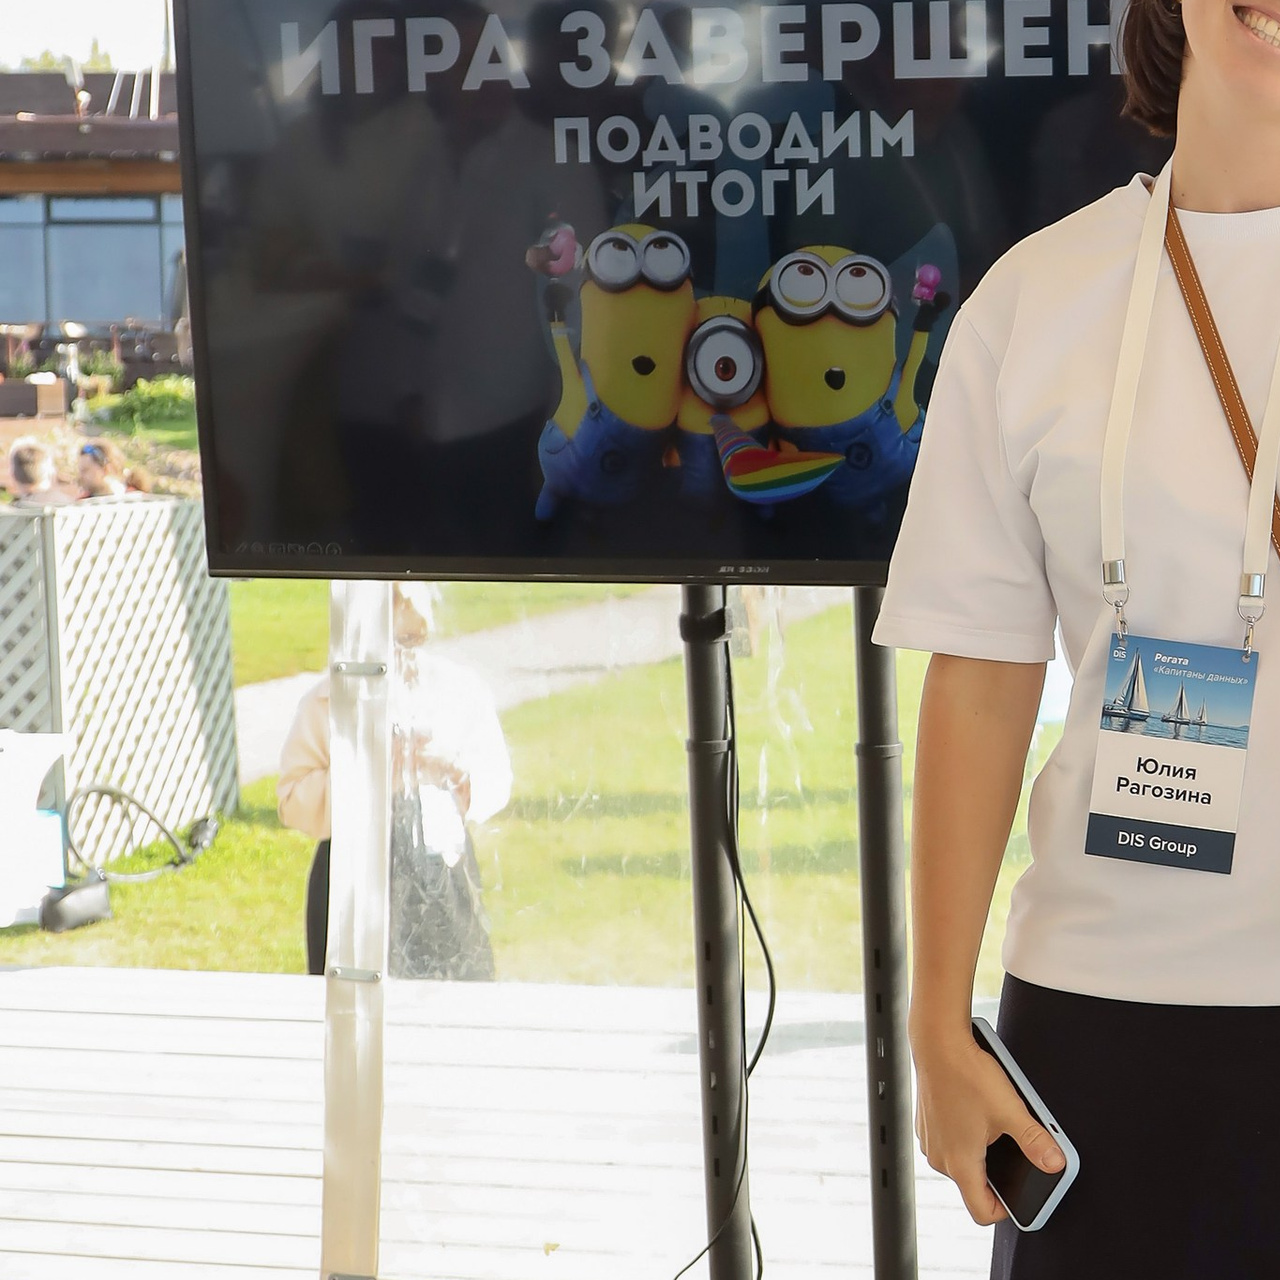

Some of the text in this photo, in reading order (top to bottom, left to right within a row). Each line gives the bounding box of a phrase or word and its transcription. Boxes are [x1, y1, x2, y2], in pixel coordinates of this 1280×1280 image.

[280, 13, 530, 96] ИГРА
[553, 109, 915, 166] ПОДВОДИМ
[633, 168, 835, 218] ИТОГИ
[1113, 648, 1127, 659] DIS
[1154, 652, 1190, 666] Регата
[1153, 664, 1249, 686] «Капитаны данных»
[1136, 756, 1197, 780] Юлия
[1116, 776, 1212, 805] Рагозина
[1117, 830, 1198, 858] DIS Group
